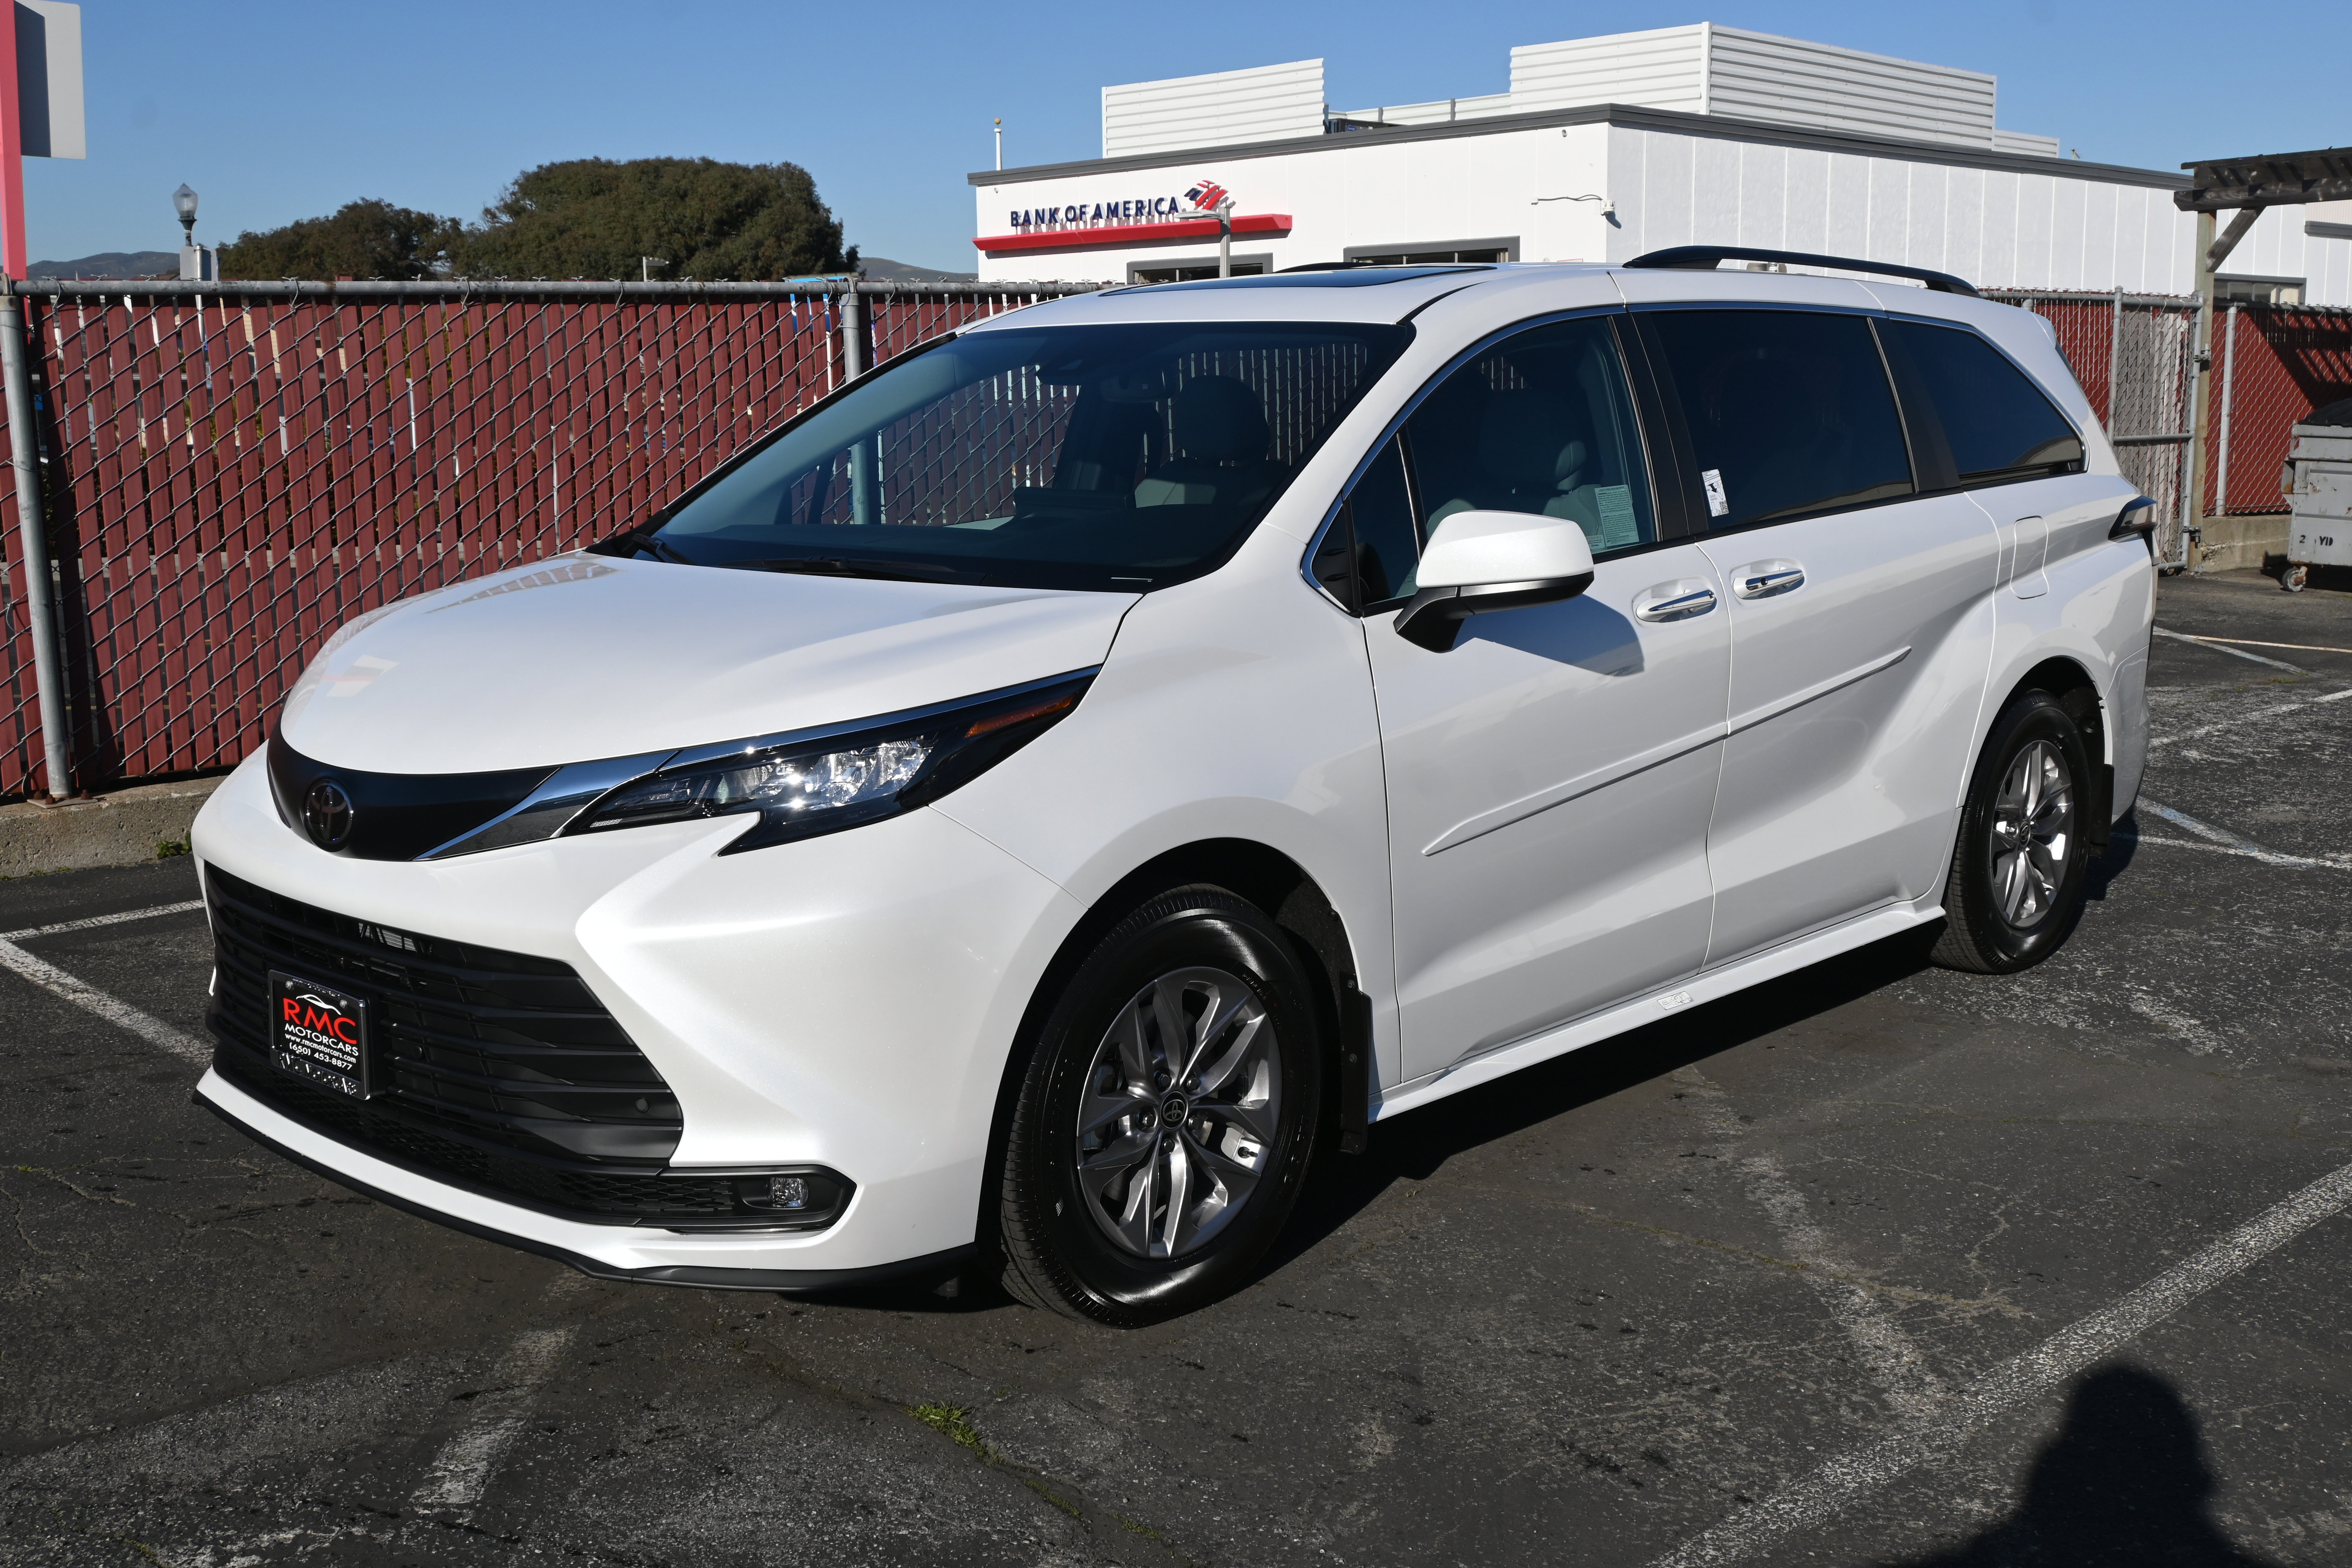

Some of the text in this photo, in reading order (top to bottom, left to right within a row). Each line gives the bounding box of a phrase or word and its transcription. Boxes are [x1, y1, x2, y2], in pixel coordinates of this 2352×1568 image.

[1010, 196, 1181, 227] BANK OF AMERICA
[2299, 534, 2306, 544] 2
[283, 998, 357, 1045] RMC
[284, 1023, 359, 1056] MOTORCARS
[285, 1033, 357, 1064] www.rmcmotorcars.com
[289, 1042, 353, 1070] (650) 453-8877
